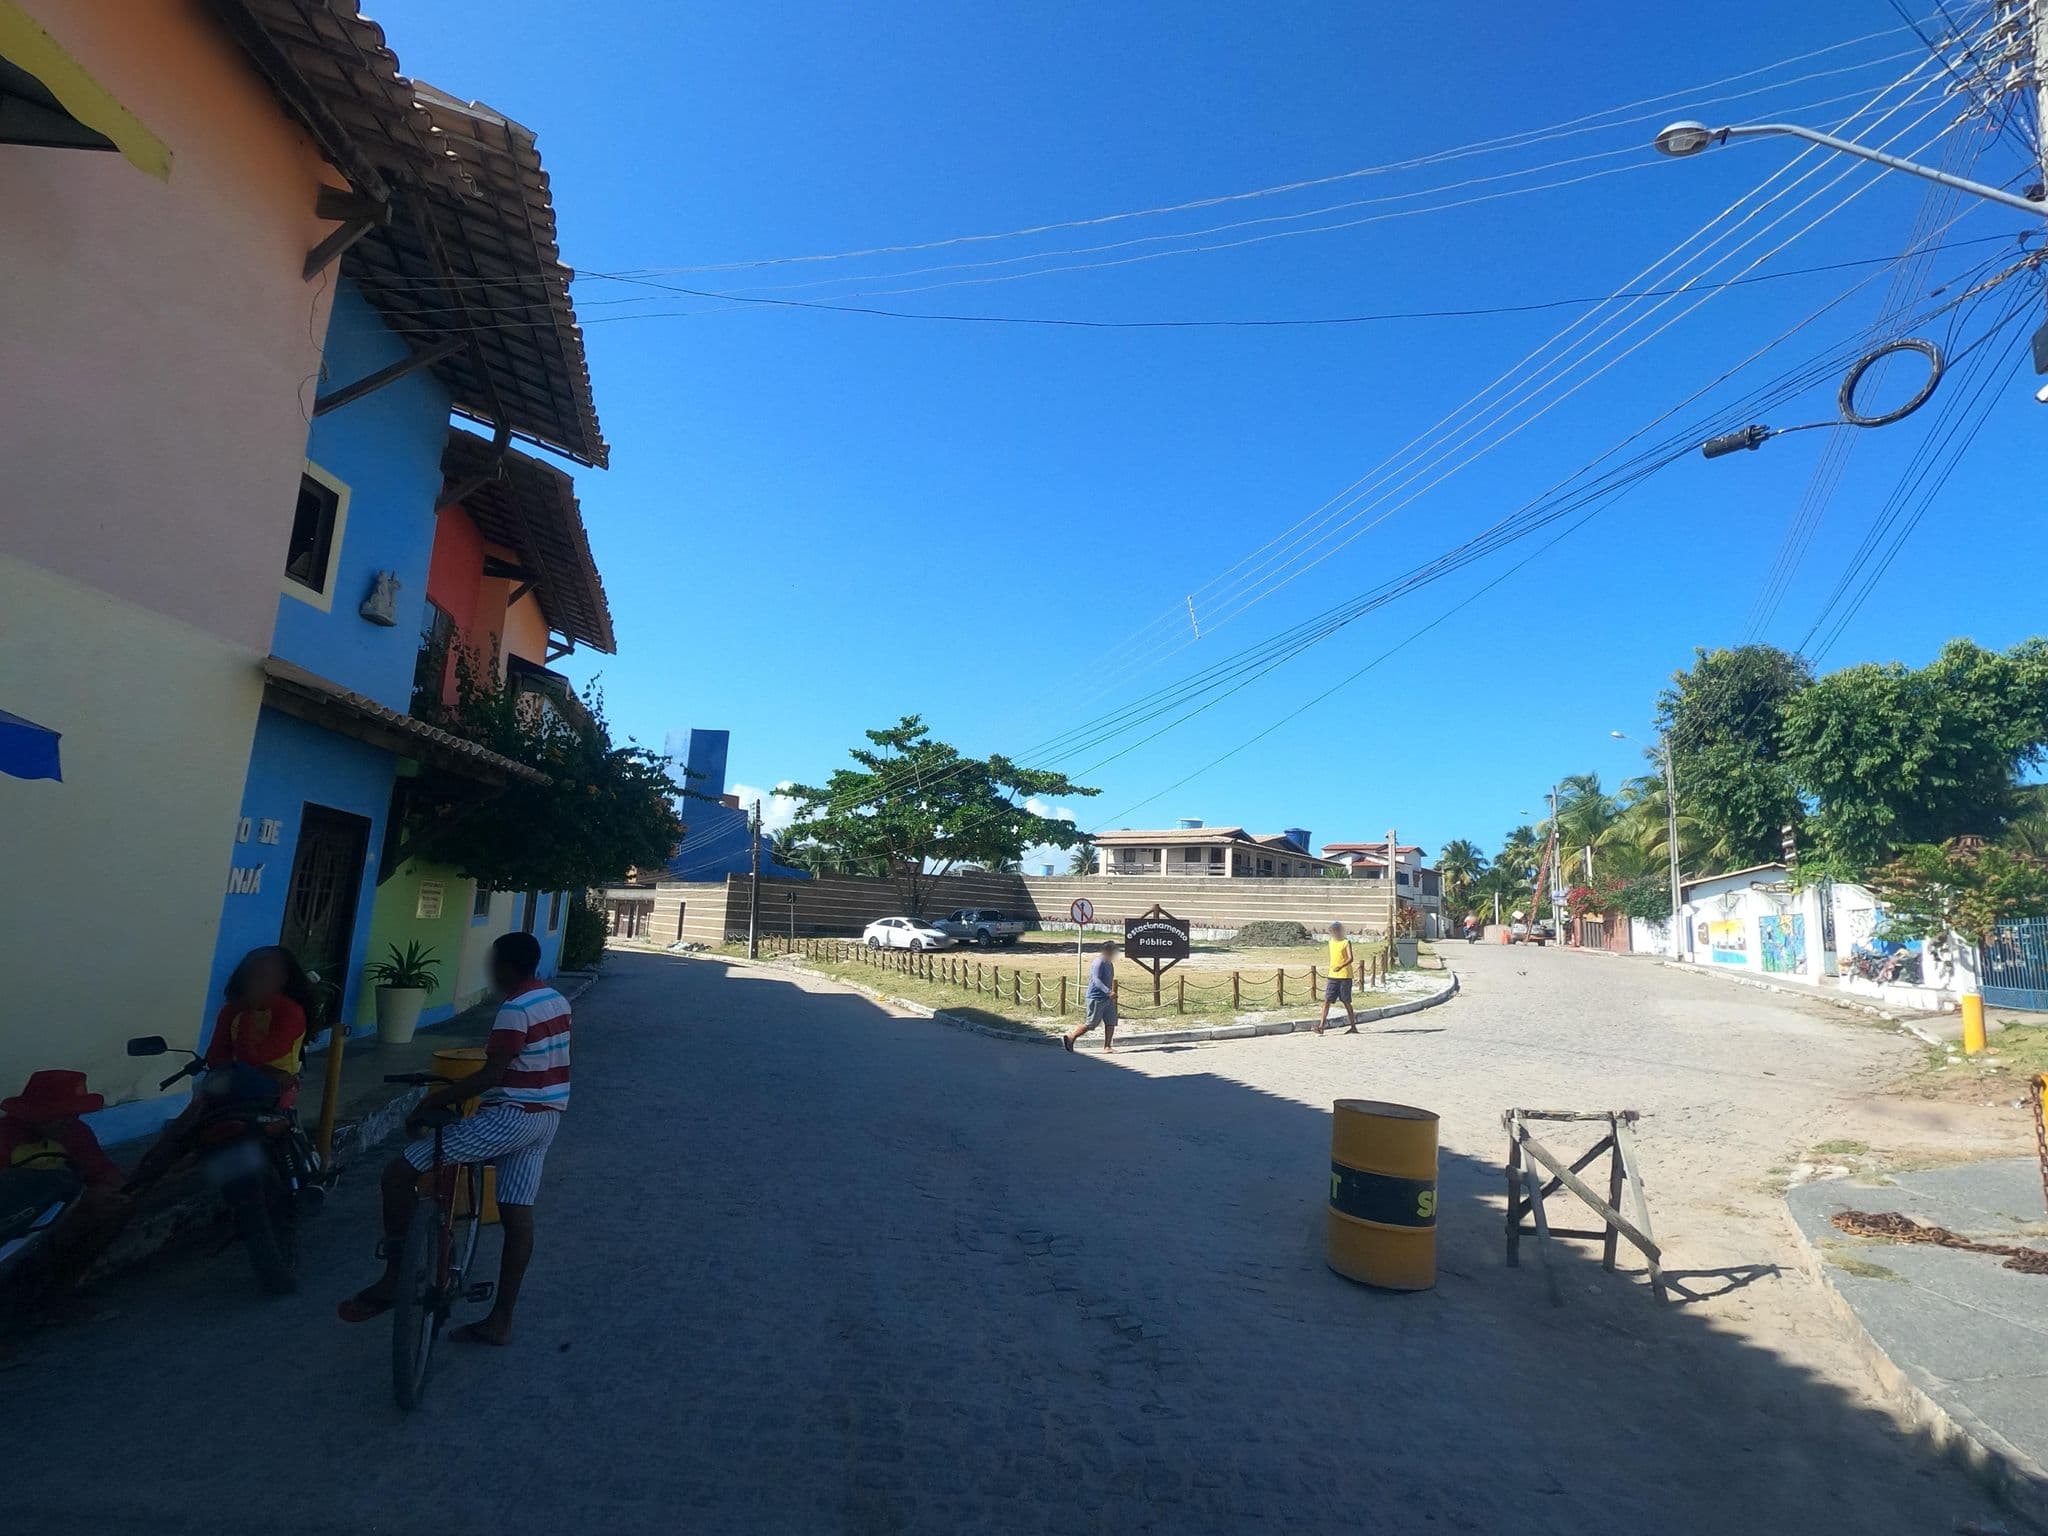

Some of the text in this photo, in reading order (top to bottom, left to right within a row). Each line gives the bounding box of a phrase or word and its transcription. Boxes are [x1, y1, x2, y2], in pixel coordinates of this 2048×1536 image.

[258, 817, 282, 845] DE
[1127, 921, 1188, 941] estacionamento
[1139, 938, 1173, 946] Público
